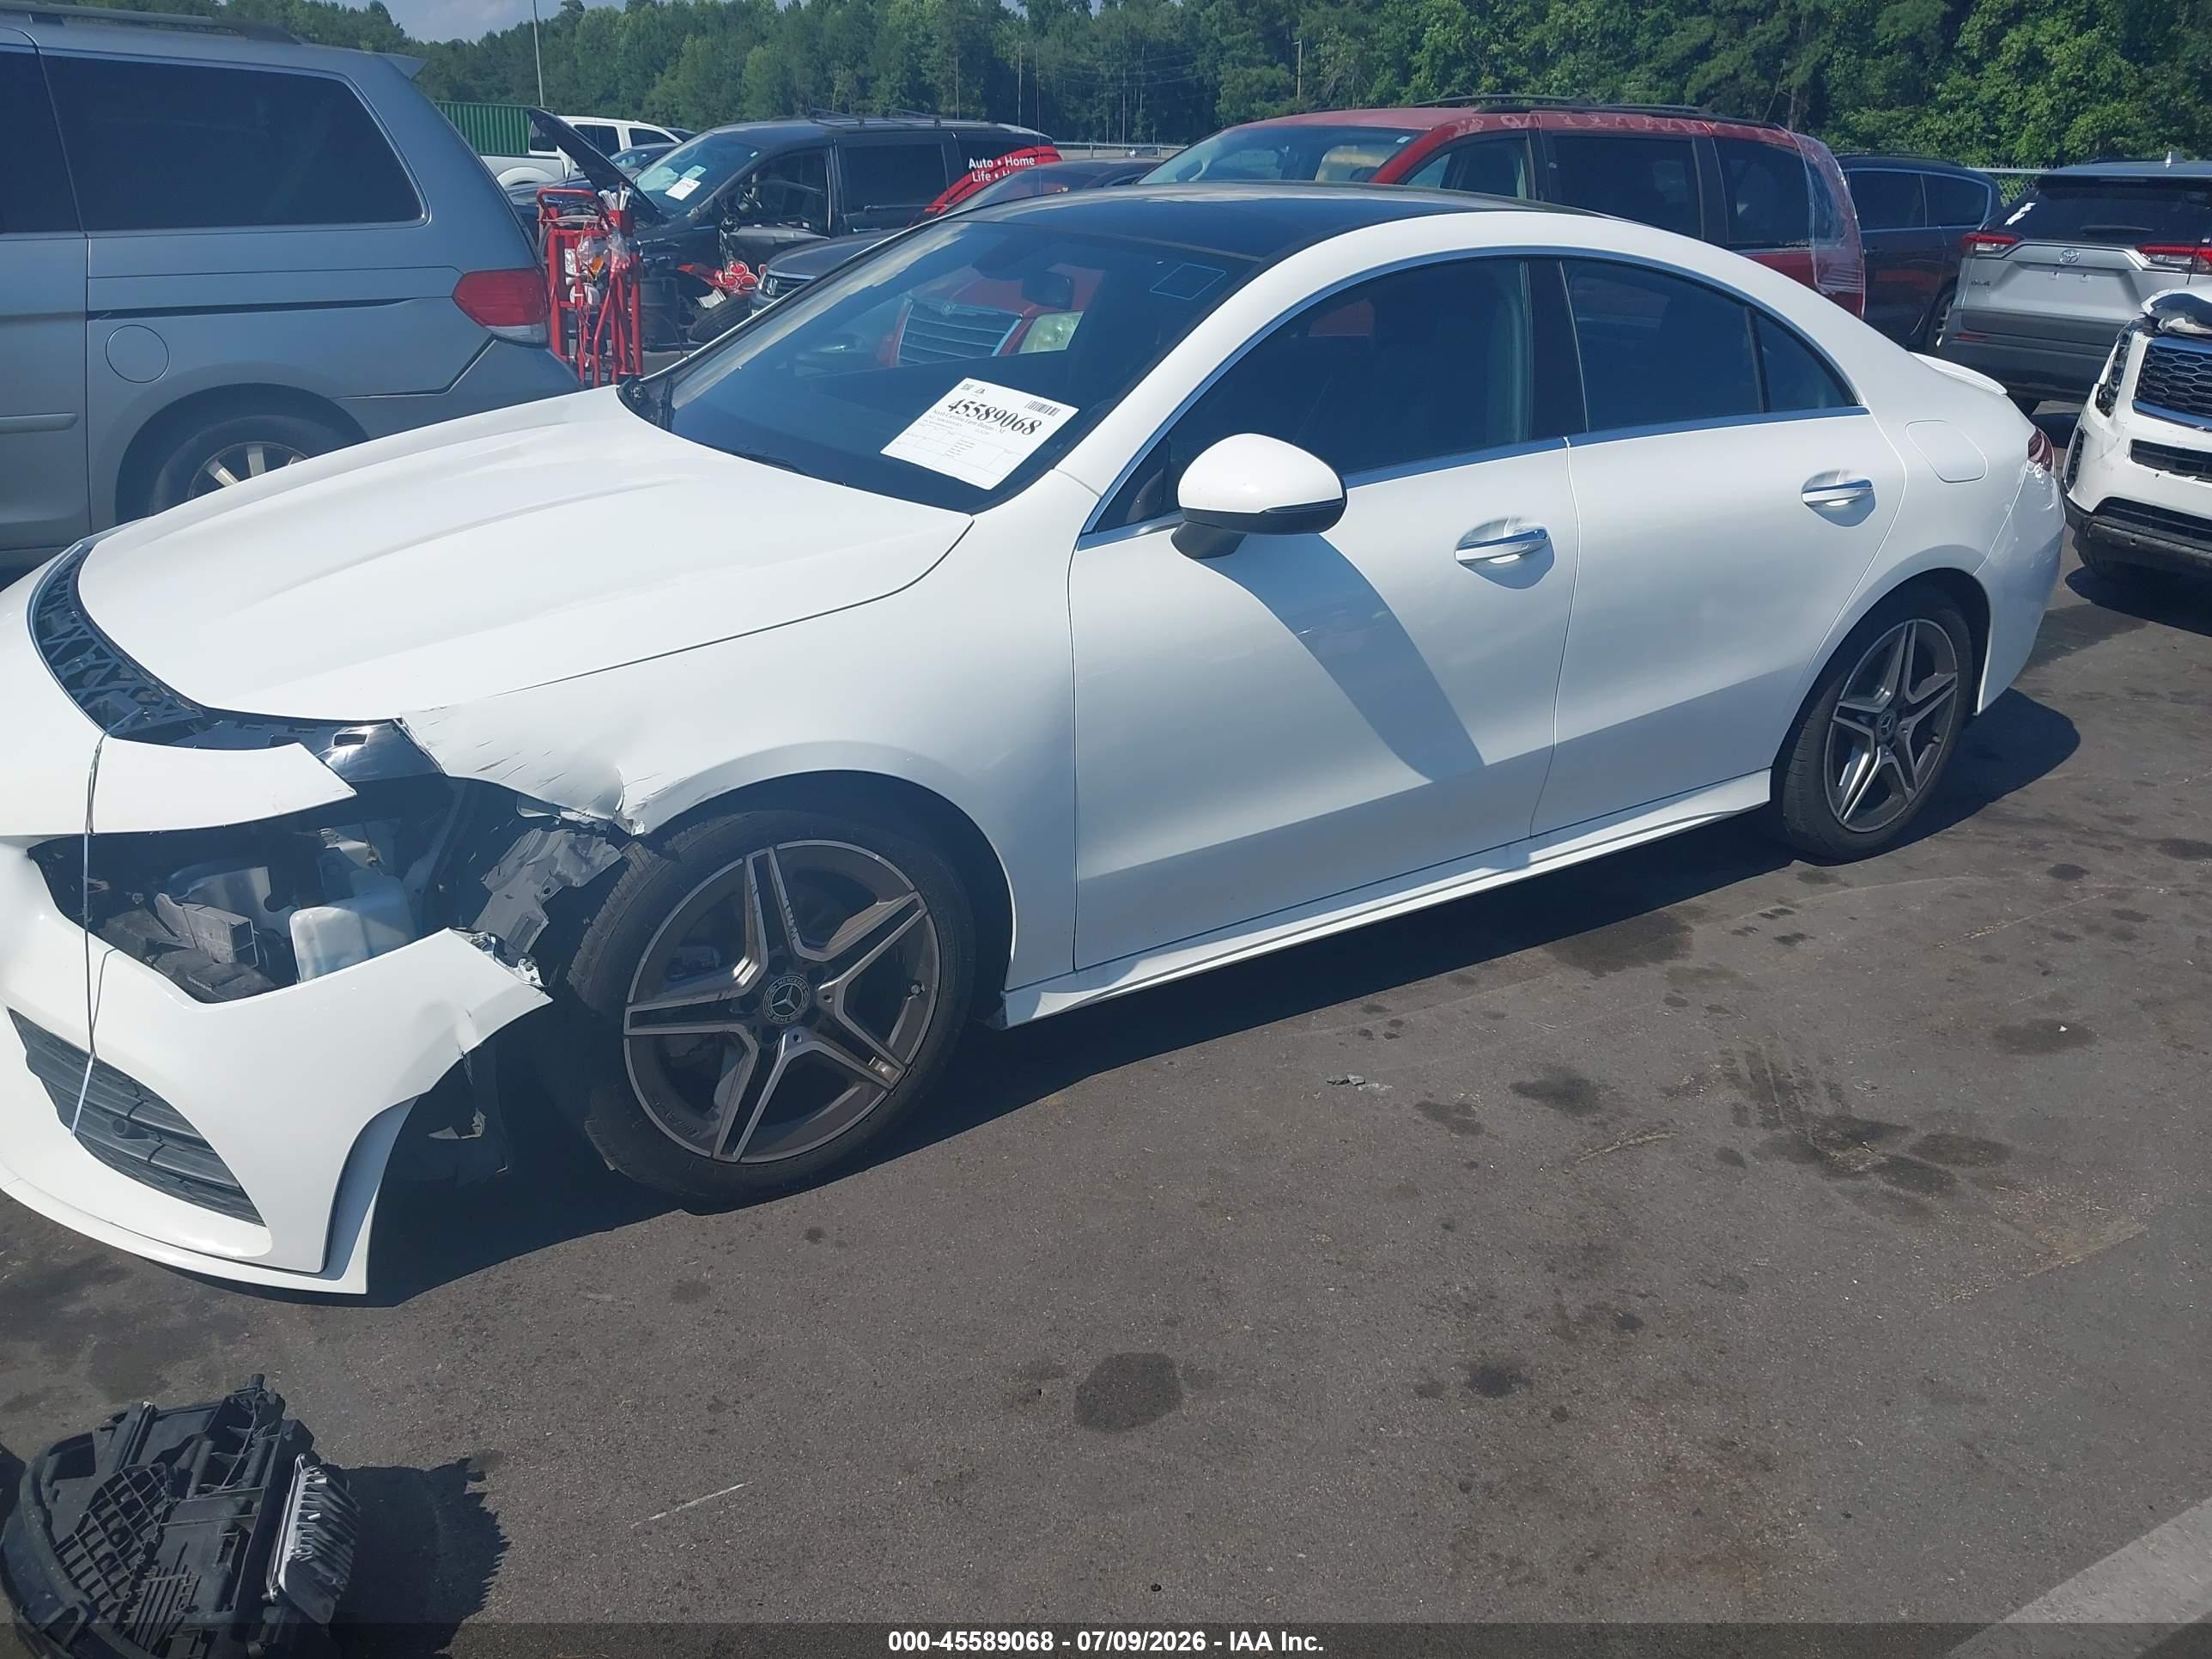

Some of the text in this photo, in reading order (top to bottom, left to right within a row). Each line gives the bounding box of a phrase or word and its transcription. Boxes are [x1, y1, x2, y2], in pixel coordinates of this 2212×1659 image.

[969, 155, 1036, 169] Auto Home
[972, 171, 991, 182] Life
[948, 398, 1042, 434] 45589068
